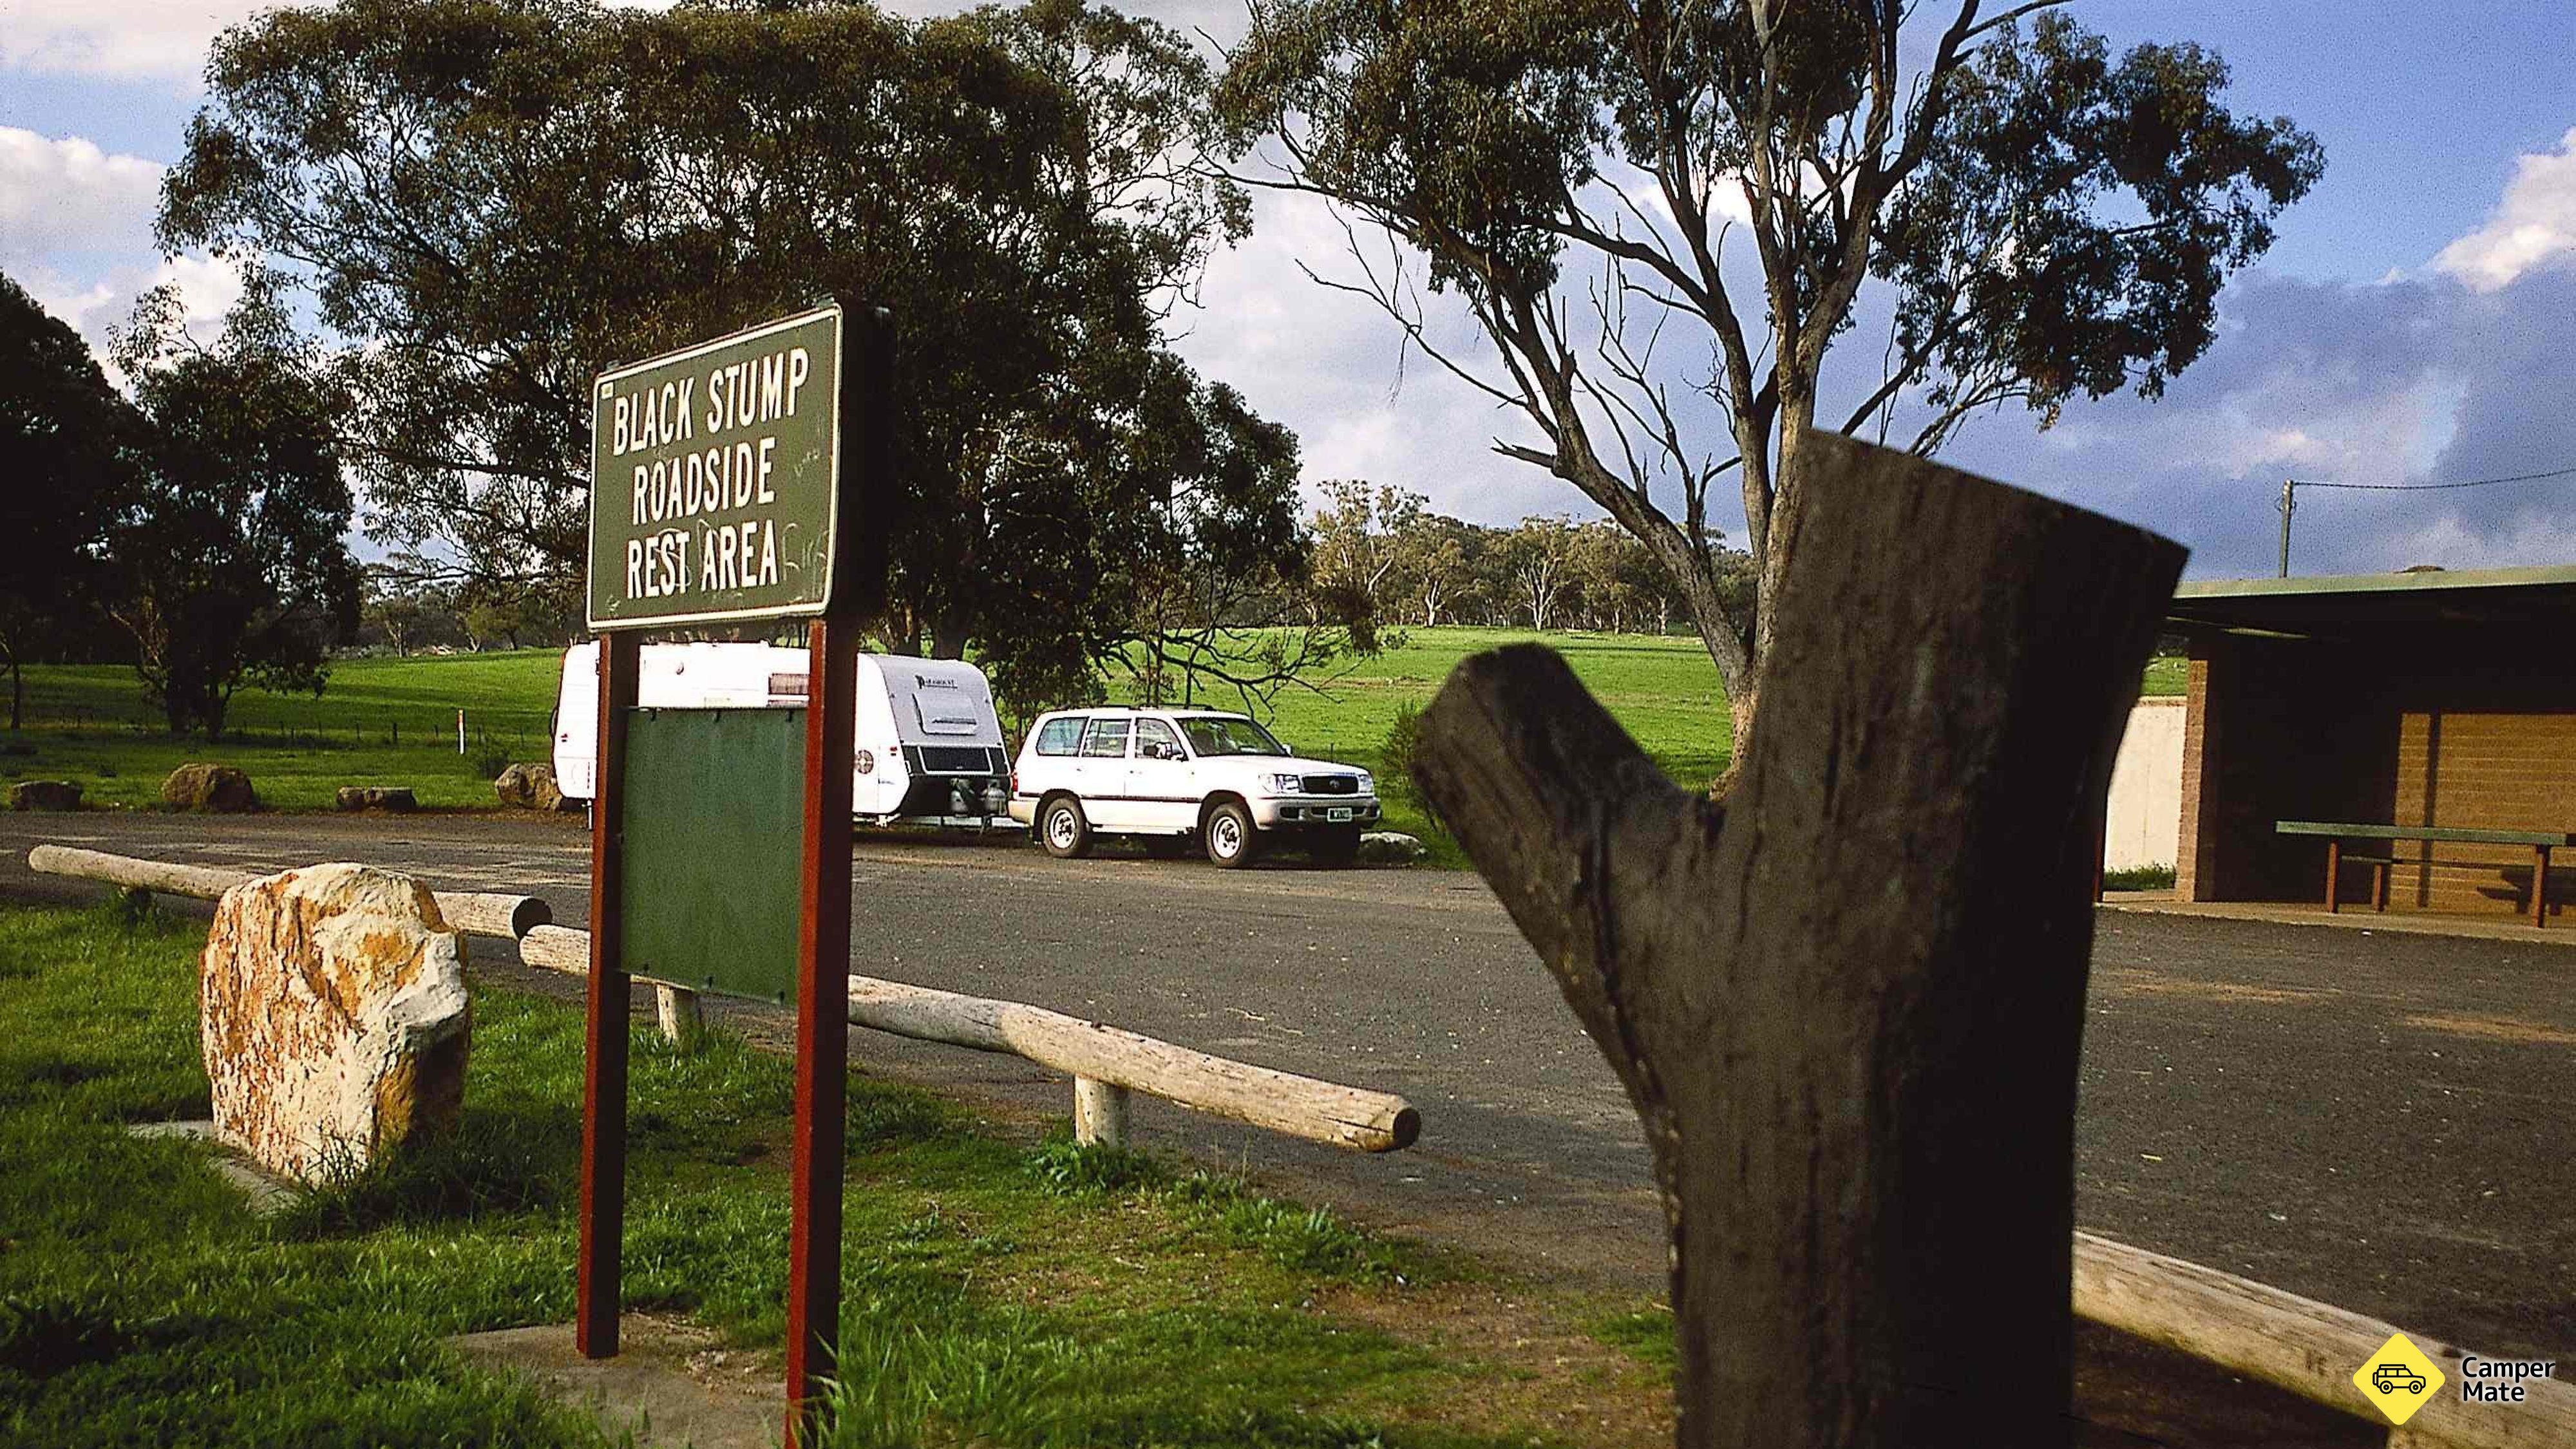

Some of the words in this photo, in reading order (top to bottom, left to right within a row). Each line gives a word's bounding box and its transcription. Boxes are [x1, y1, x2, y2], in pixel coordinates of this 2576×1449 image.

[613, 377, 696, 455] BLACK
[707, 348, 809, 434] STUMP
[632, 437, 776, 526] ROADSIDE
[627, 531, 690, 599] REST
[701, 520, 778, 592] AREA
